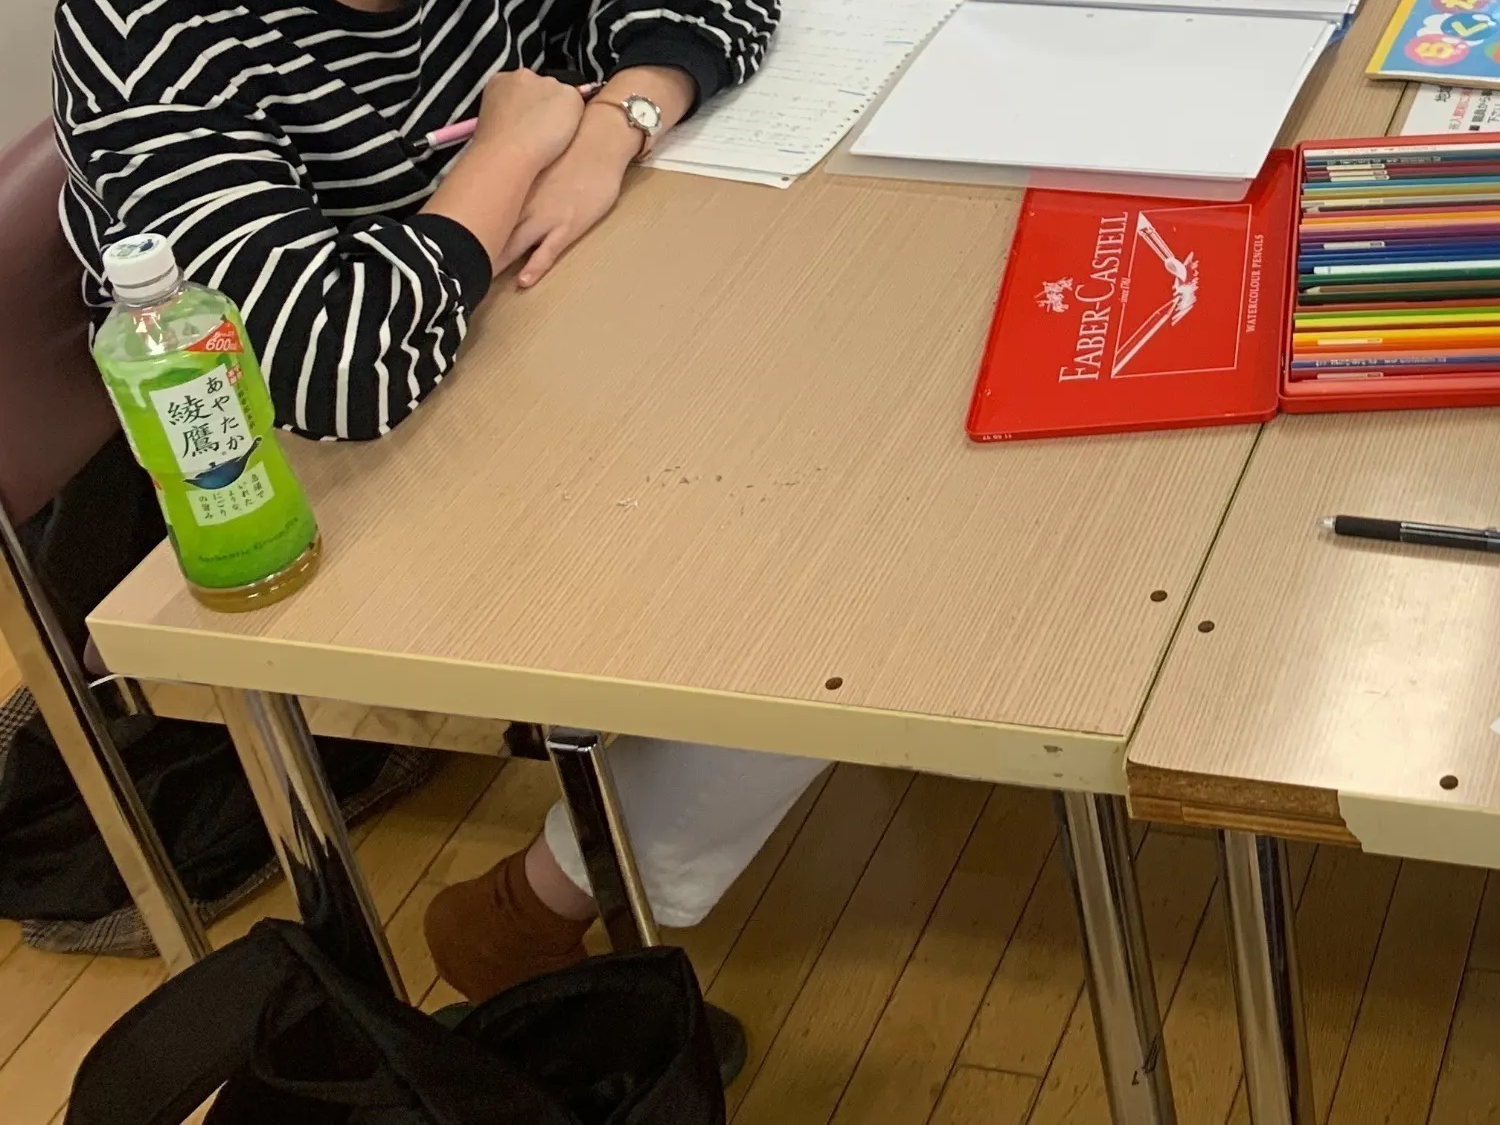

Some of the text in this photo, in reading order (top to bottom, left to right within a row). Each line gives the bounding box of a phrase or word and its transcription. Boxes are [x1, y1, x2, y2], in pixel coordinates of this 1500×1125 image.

[1058, 211, 1129, 383] FABER-CASTELL
[1246, 234, 1265, 334] WATERCOLOUR PENCILS
[167, 394, 220, 459] 綾鷹
[205, 376, 245, 451] あやたか
